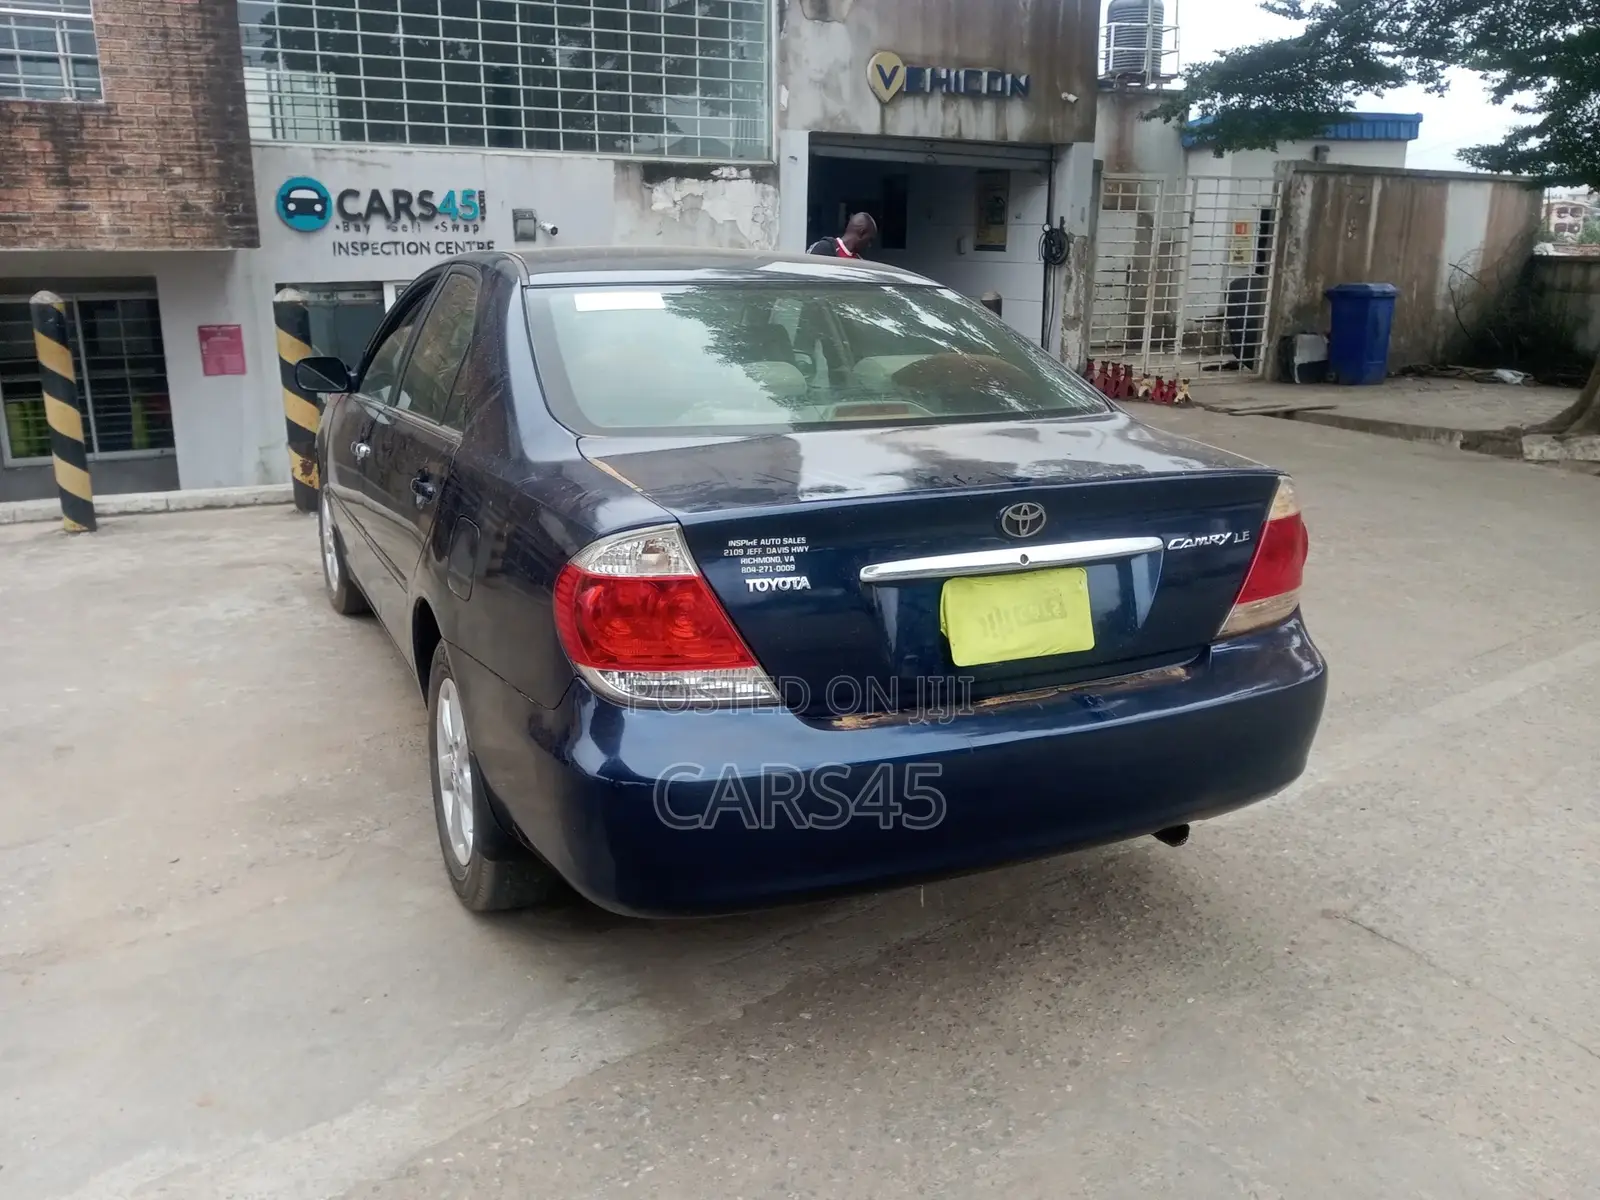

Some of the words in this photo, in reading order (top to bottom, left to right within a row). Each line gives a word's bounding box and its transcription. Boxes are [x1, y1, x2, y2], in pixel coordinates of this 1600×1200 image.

[337, 189, 478, 221] CARS45
[342, 221, 370, 234] Buy
[440, 221, 479, 235] Swap
[332, 241, 431, 257] INSPECTION
[1167, 531, 1232, 551] CAMRY
[1234, 530, 1250, 543] LE
[766, 546, 790, 555] DAVIS
[784, 555, 795, 563] VA
[745, 576, 811, 593] TOYOTA
